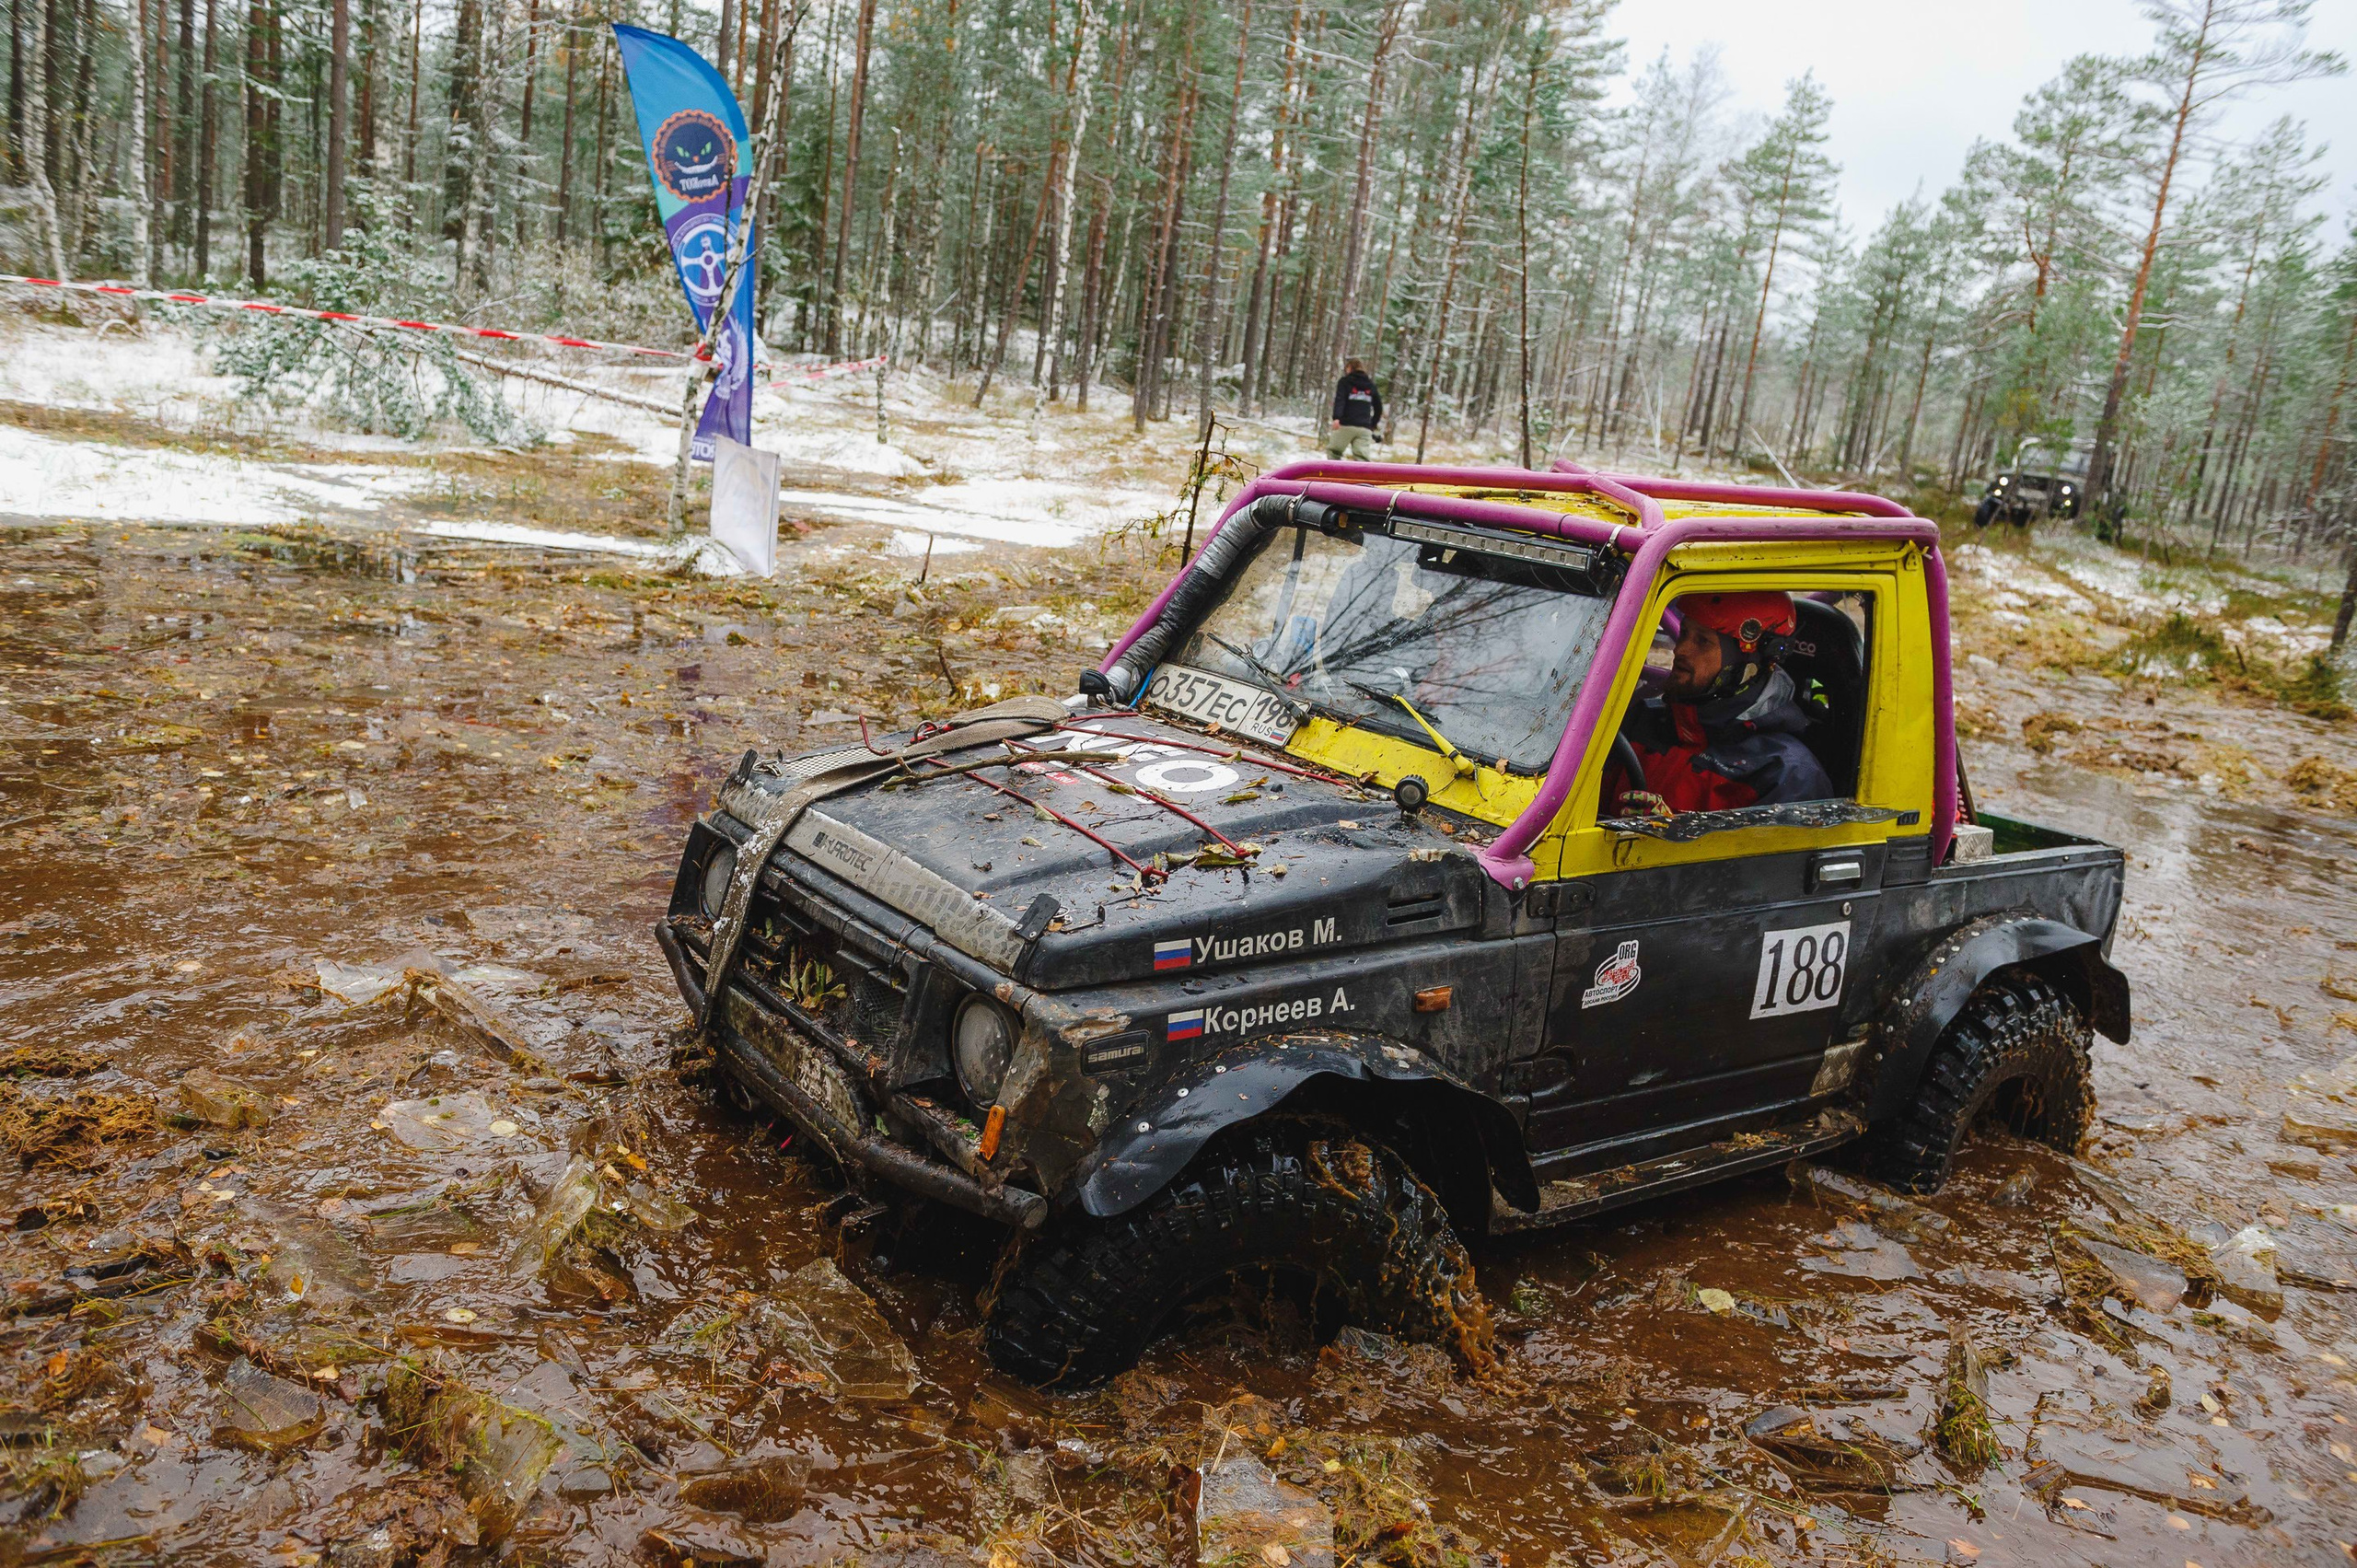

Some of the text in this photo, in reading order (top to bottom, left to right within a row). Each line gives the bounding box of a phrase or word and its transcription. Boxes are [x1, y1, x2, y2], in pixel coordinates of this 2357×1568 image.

[1251, 722, 1272, 737] RUS
[1195, 917, 1341, 964] Ушаков М.
[1619, 943, 1637, 959] ORG
[1759, 931, 1845, 1010] 188
[1585, 985, 1619, 998] АВТОСПОРТ
[1204, 987, 1355, 1036] Корнеев А.
[1087, 1046, 1144, 1063] samurai
